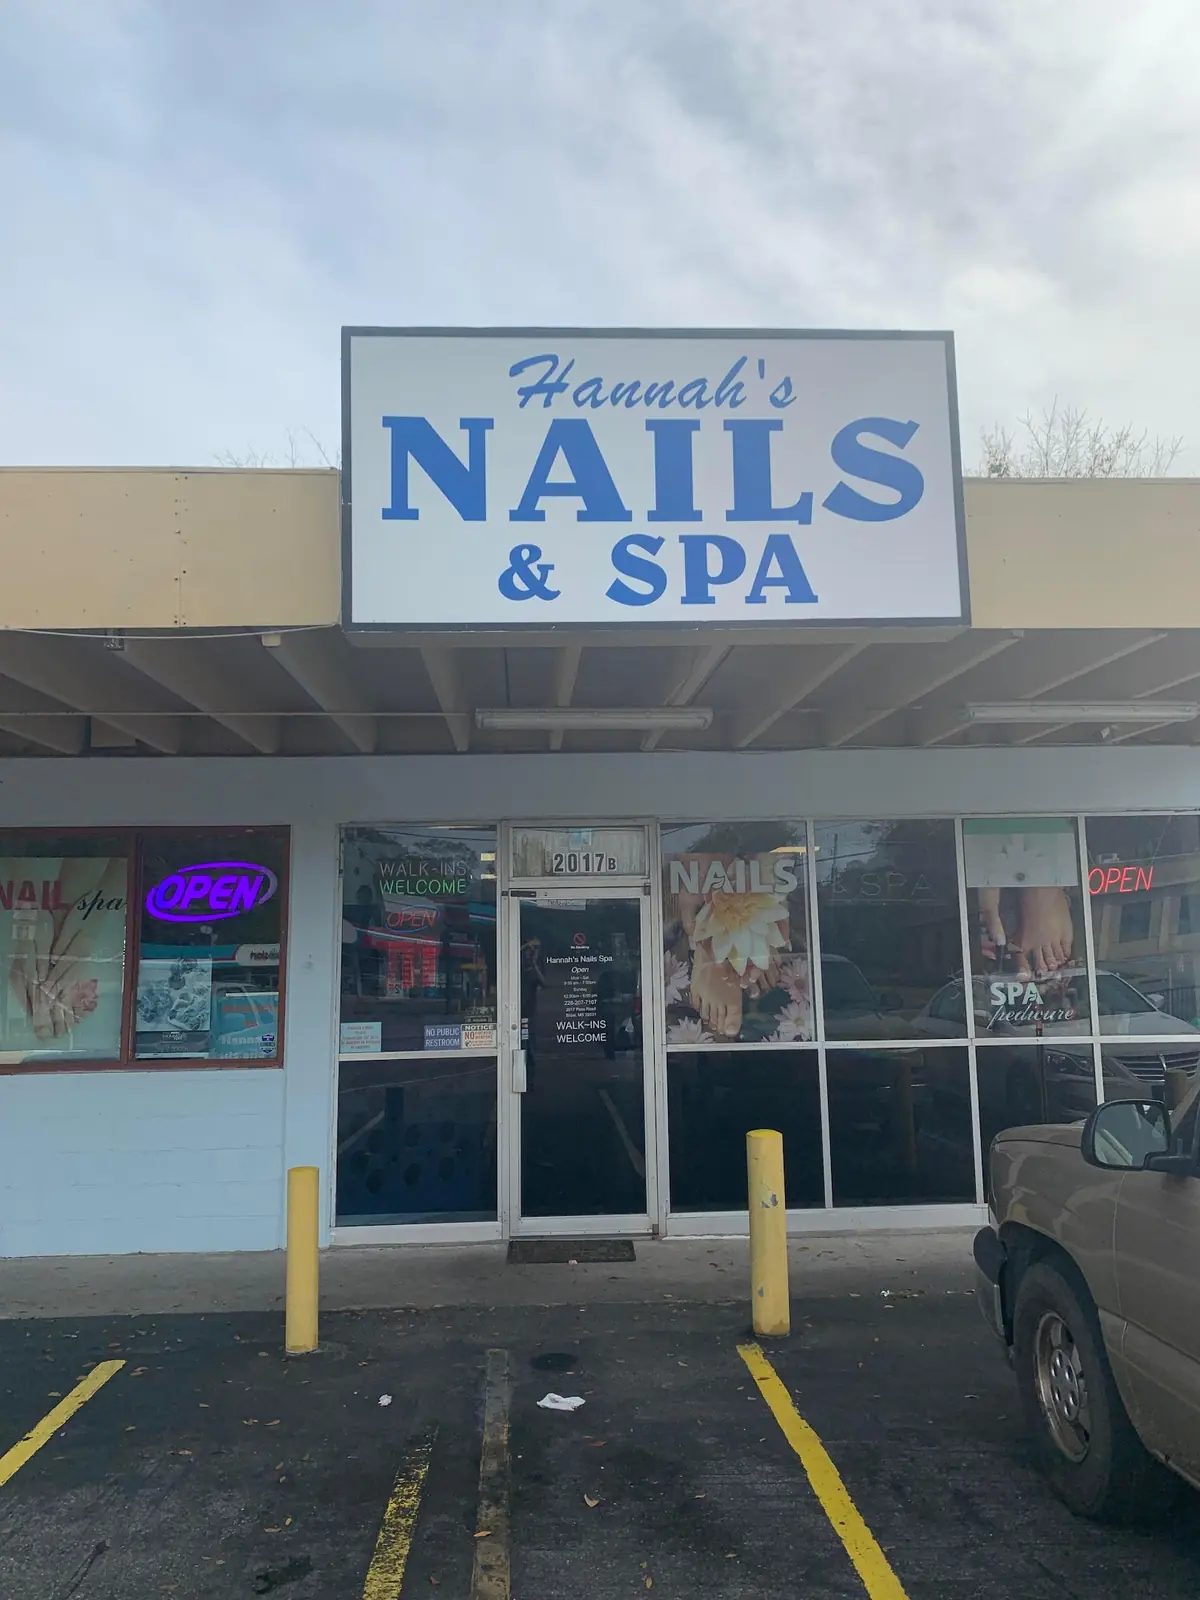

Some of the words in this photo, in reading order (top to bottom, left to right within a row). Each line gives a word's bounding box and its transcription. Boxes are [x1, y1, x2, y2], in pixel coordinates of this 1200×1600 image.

[508, 353, 798, 410] Hannah's
[382, 415, 925, 525] NAILS
[498, 543, 561, 601] &
[605, 533, 819, 607] SPA
[379, 861, 468, 877] WALK-INS
[670, 858, 798, 894] NAILS
[1088, 866, 1154, 895] OPEN
[153, 874, 264, 911] OPEN
[379, 878, 467, 895] WELCOME
[861, 872, 937, 896] SPA
[0, 880, 70, 910] NAIL
[77, 889, 127, 921] spa
[386, 910, 437, 928] OPEN
[546, 956, 579, 964] Hannah's
[580, 955, 597, 963] Nails
[598, 954, 613, 963] Spa
[571, 966, 590, 974] Open
[989, 982, 1044, 1006] SPA
[986, 1002, 1076, 1031] pedicure
[425, 1028, 435, 1037] NO
[436, 1027, 460, 1036] PUBLIC
[425, 1038, 460, 1047] RESTROOM
[464, 1031, 475, 1040] NO
[556, 1033, 607, 1043] WELCOME
